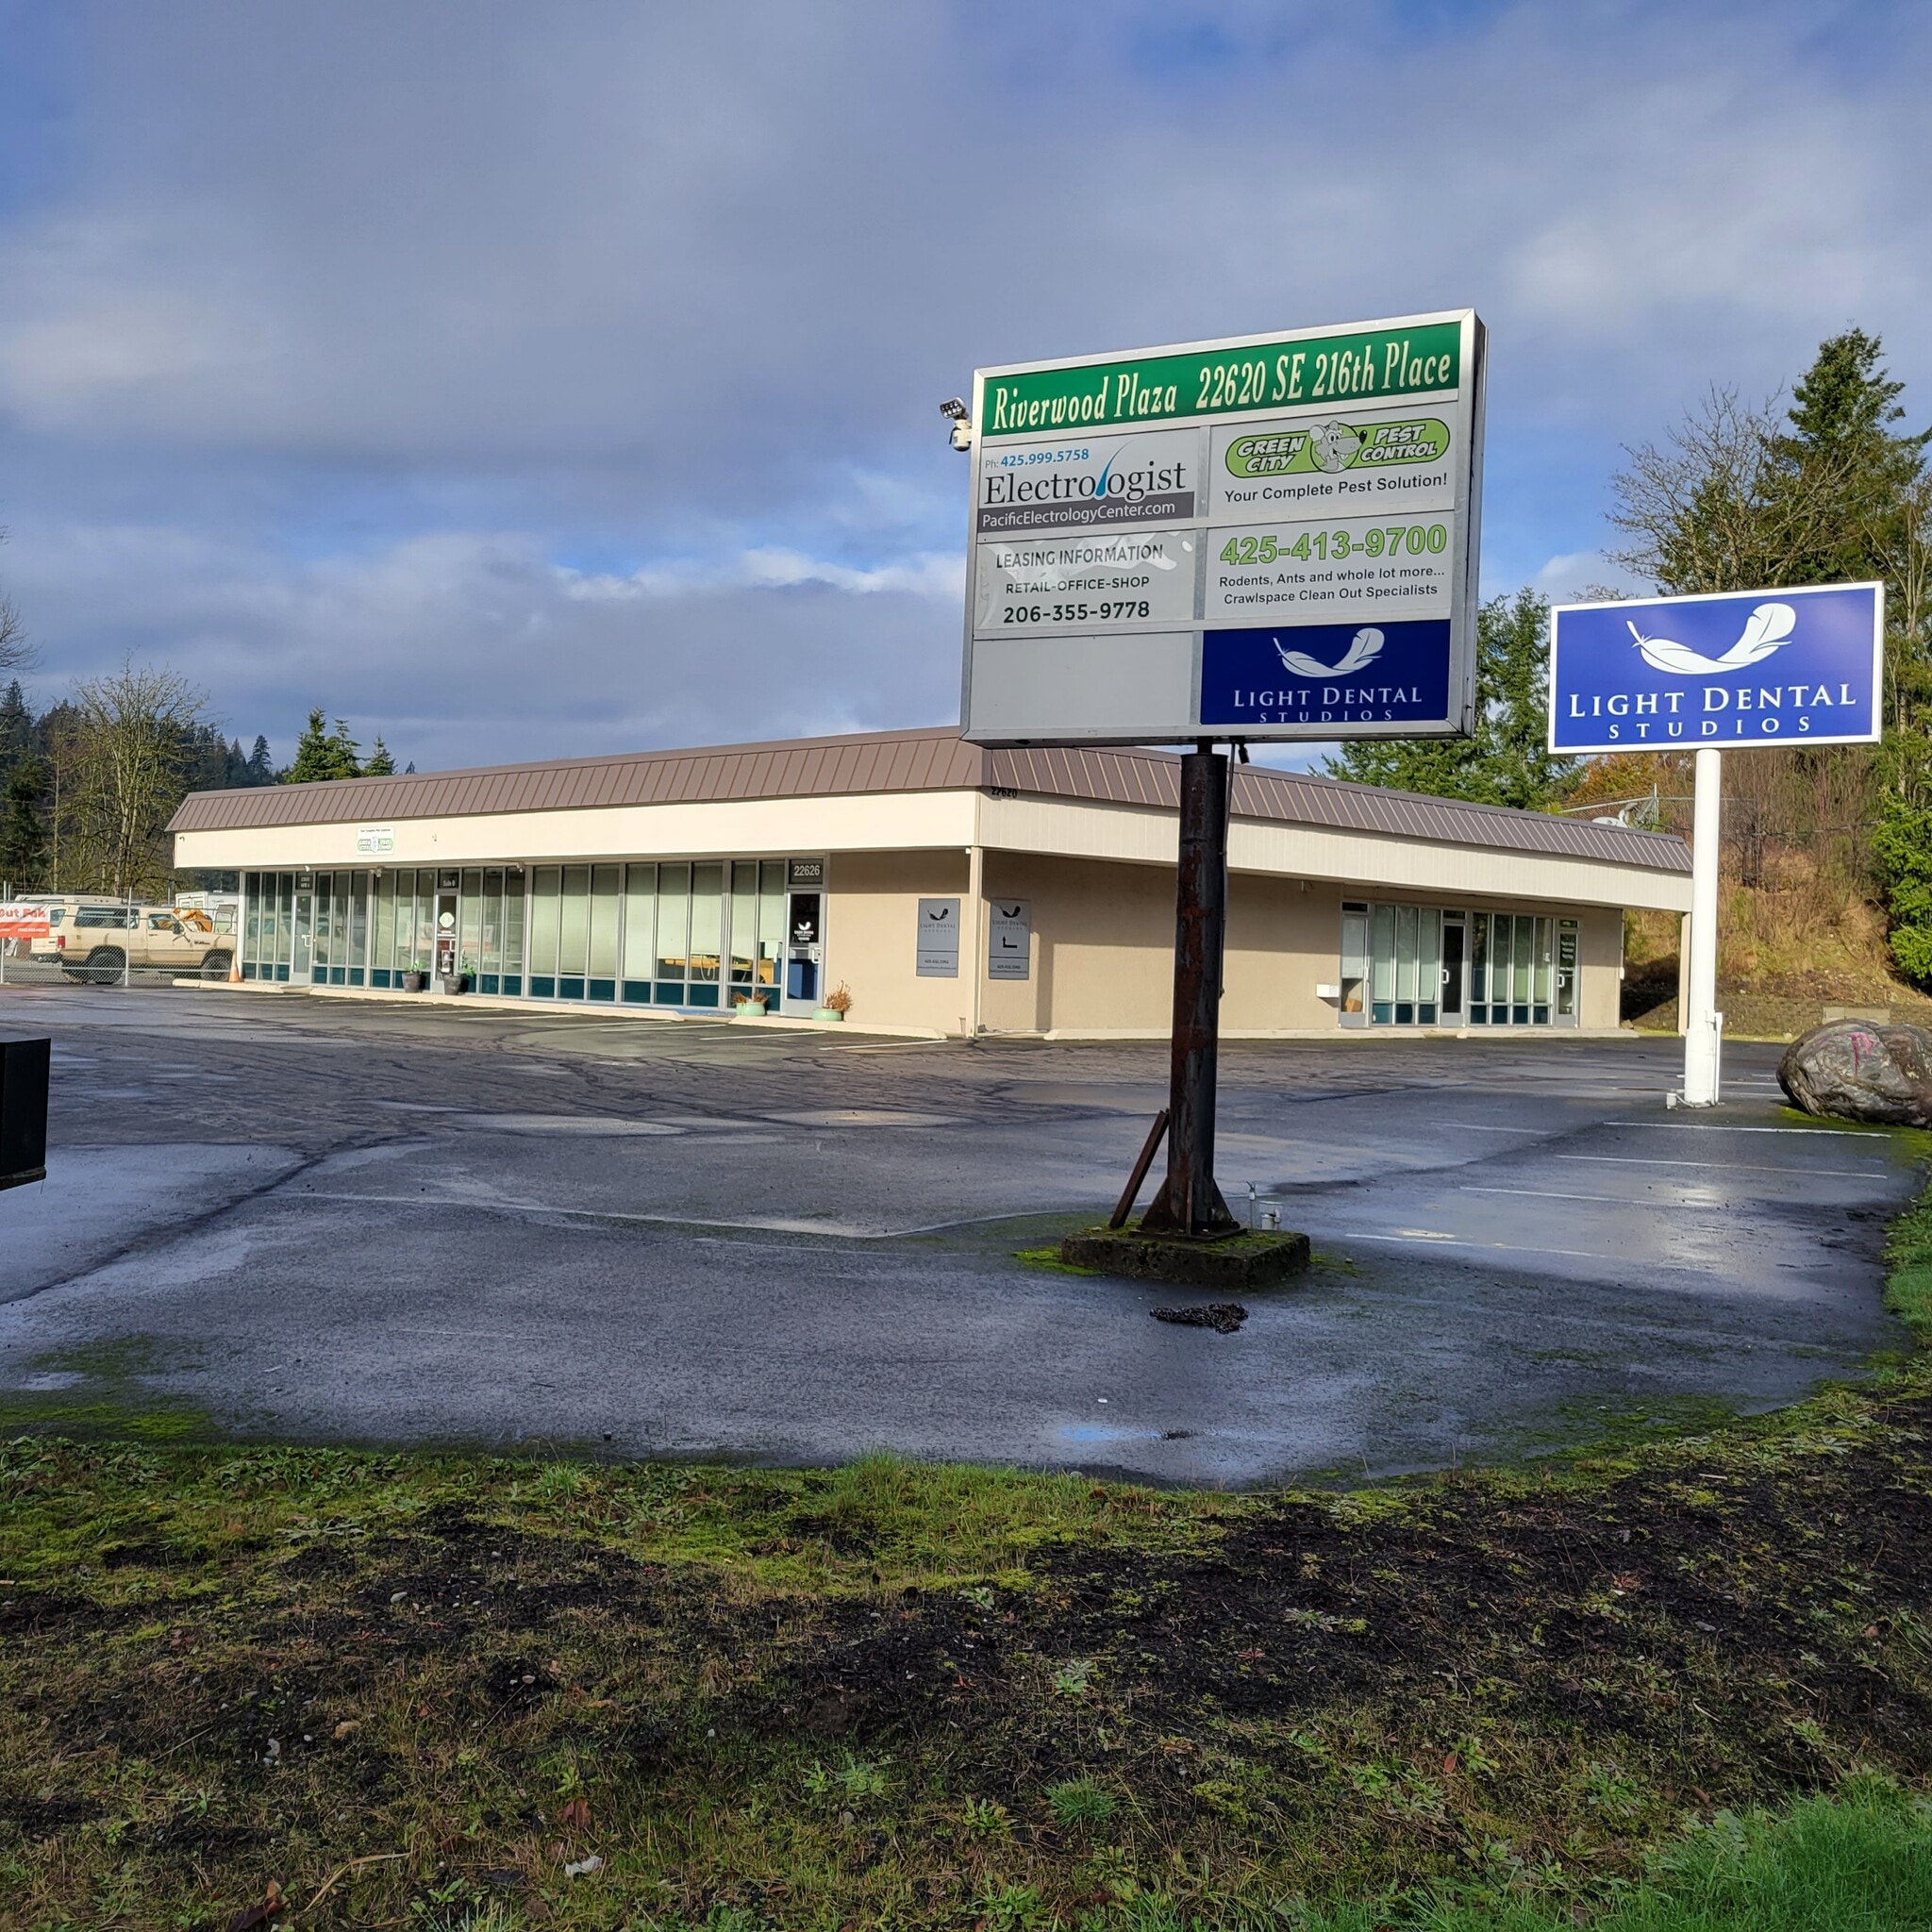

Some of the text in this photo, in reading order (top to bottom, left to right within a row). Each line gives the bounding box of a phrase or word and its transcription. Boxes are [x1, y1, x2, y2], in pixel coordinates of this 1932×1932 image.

[991, 340, 1451, 430] Riverwood Plaza 22620 SE 216th Place
[1374, 424, 1425, 445] PEST
[1237, 435, 1307, 457] GREEN
[1360, 441, 1437, 462] CONTROL
[985, 448, 1090, 469] Ph: 425.999.5758
[1245, 454, 1296, 473] CITY
[1224, 473, 1448, 503] Your Complete Pest Solution!
[982, 501, 1175, 527] PacificElectrologyCenter.com
[996, 544, 1163, 568] LEASING INFORMATION
[1219, 524, 1448, 566] 425-413-9700
[1006, 576, 1150, 593] RETAIL-OFFICE-SHOP
[1219, 566, 1445, 588] Rodents, Ants and whole lot more...
[1224, 584, 1438, 605] Crawlspace Clean Out Specialists
[1003, 600, 1150, 624] 206-355-9778
[1234, 687, 1423, 708] LIGHT DENTAL
[1569, 684, 1857, 718] LIGHT DENTAL
[1259, 709, 1392, 724] STUDIOS
[1608, 716, 1810, 739] STUDIOS
[793, 864, 821, 876] 22626
